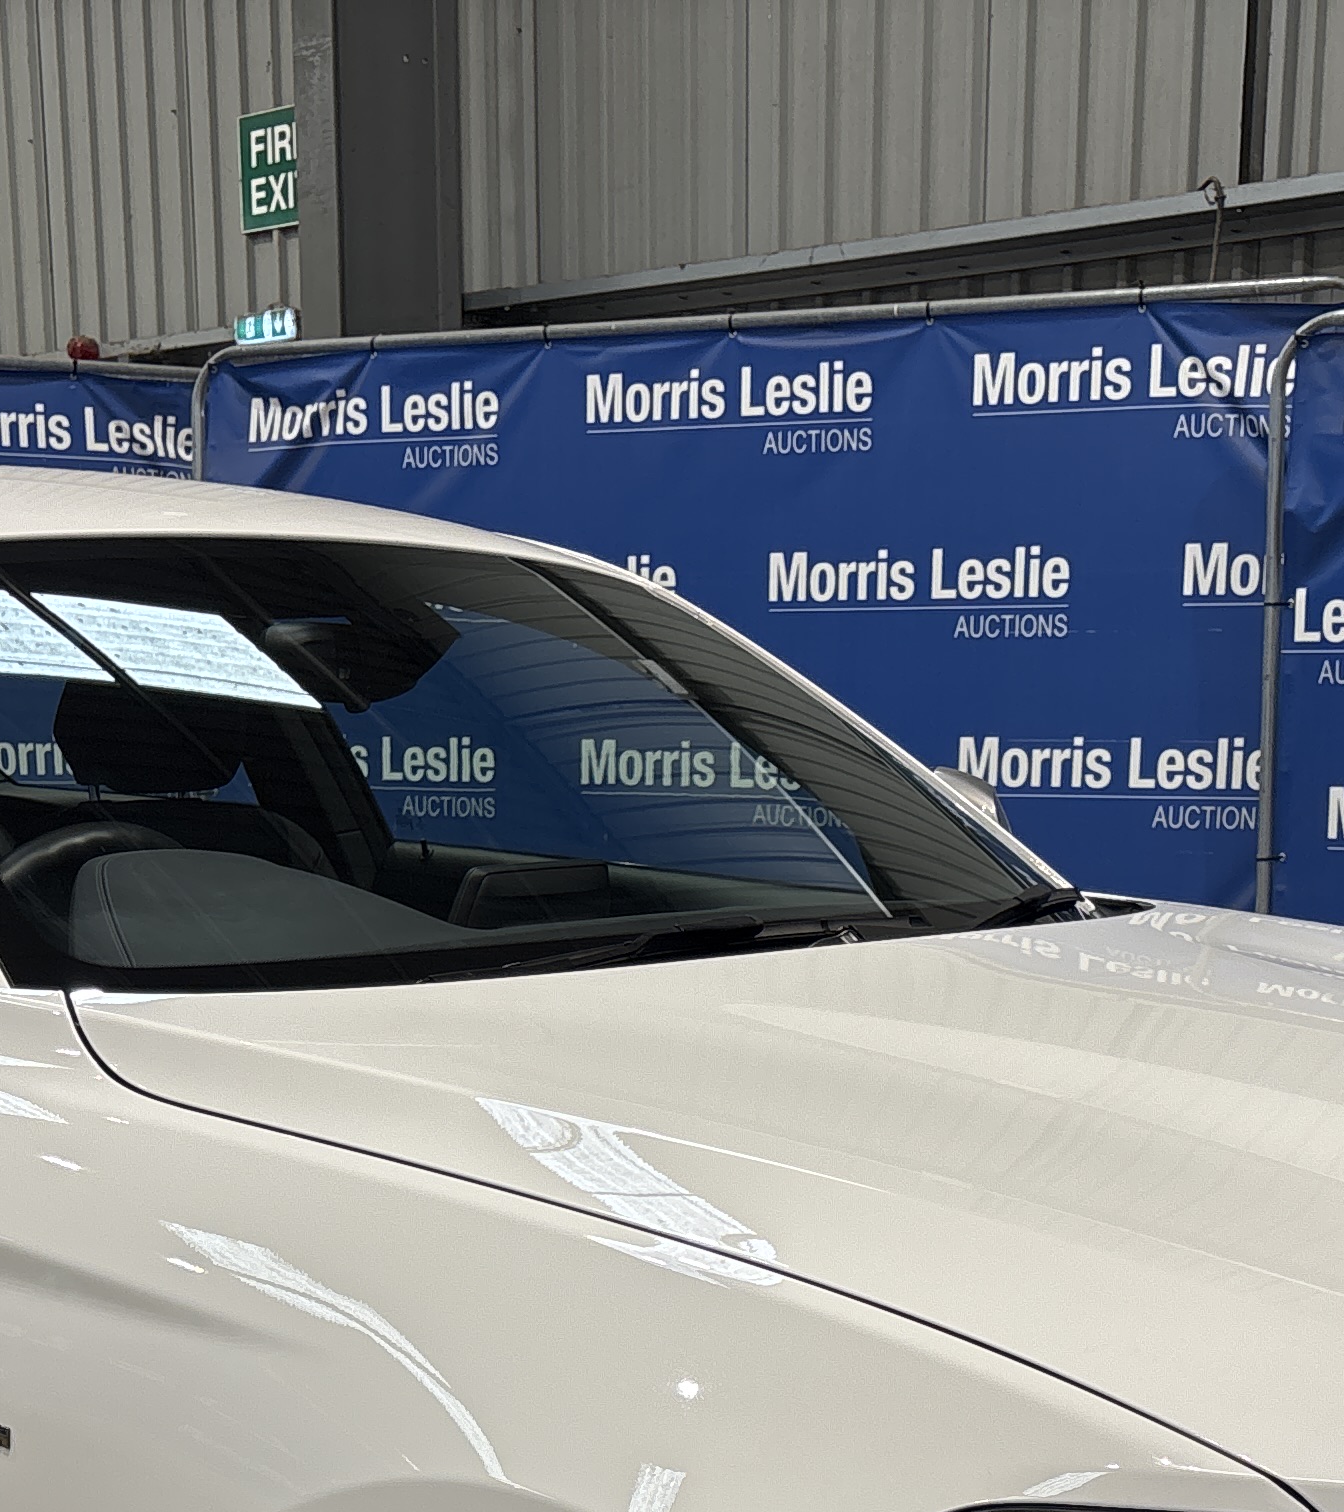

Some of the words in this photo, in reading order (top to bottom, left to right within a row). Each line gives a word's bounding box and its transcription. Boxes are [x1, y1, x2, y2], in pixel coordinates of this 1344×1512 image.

[251, 170, 297, 215] EXI
[586, 368, 725, 423] Morris
[741, 361, 872, 416] Leslie
[973, 347, 1131, 406] Morris
[84, 406, 193, 461] Leslie
[249, 389, 367, 443] Morris
[381, 381, 498, 433] Leslie
[403, 444, 498, 468] AUCTIONS
[763, 428, 871, 454] AUCTIONS
[627, 554, 676, 594] lie
[769, 549, 914, 602] Morris
[931, 545, 1070, 599] Leslie
[954, 614, 1067, 638] AUCTIONS
[381, 736, 495, 782] Leslie
[581, 739, 715, 787] Morris
[958, 736, 1111, 789] Morris
[402, 795, 495, 818] AUCTIONS
[753, 804, 848, 829] AUCTION
[1152, 805, 1256, 830] AUCTION
